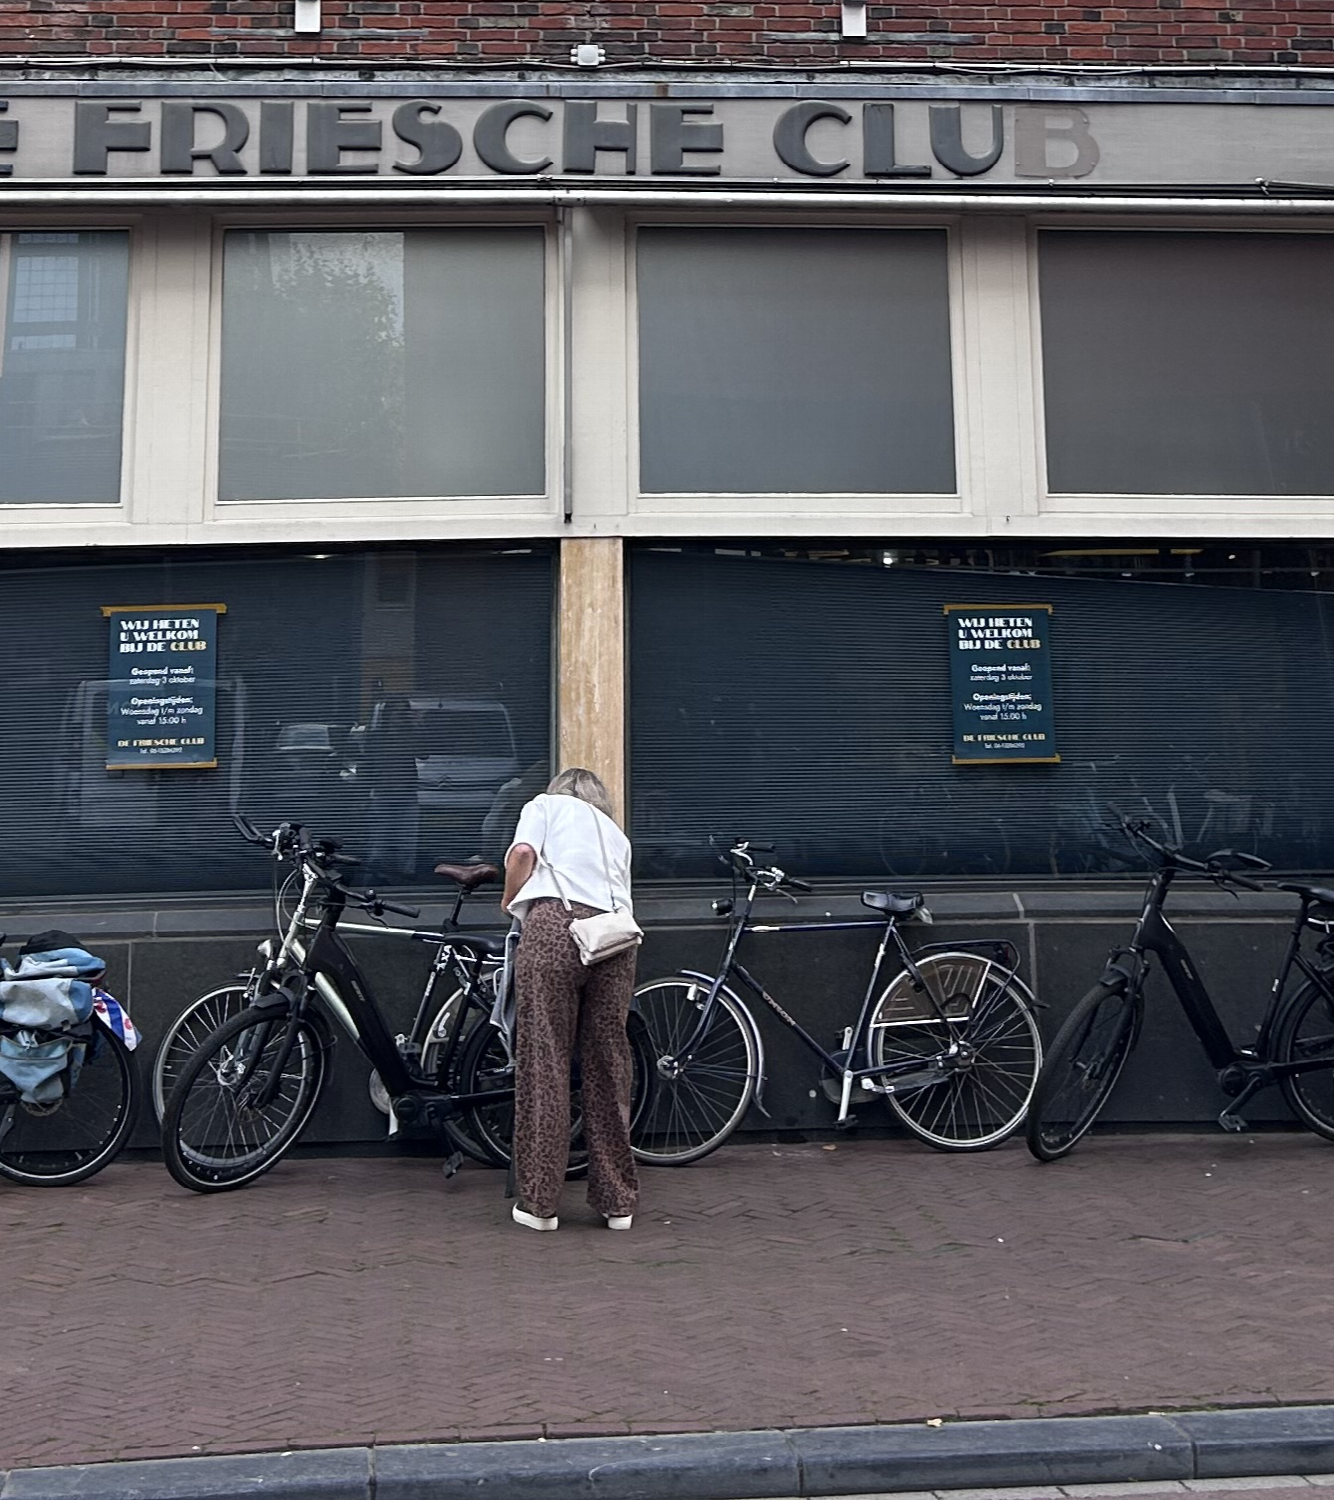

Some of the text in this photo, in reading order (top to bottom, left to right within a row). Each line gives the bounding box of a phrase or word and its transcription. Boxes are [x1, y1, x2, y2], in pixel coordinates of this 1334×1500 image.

[72, 98, 724, 176] FRIESCHE
[773, 100, 1100, 179] CLUB
[120, 618, 200, 631] WIJ HETEN
[958, 617, 1032, 628] WIJ HETEN
[120, 629, 199, 642] U WELKOM
[958, 628, 1032, 639] U WELKOM
[119, 641, 207, 653] BIJ DE CLUB
[959, 639, 1041, 650] BIJ DE CLUB
[176, 706, 203, 716] zondag
[964, 703, 1000, 712] Woensdag
[1016, 702, 1042, 712] zondag
